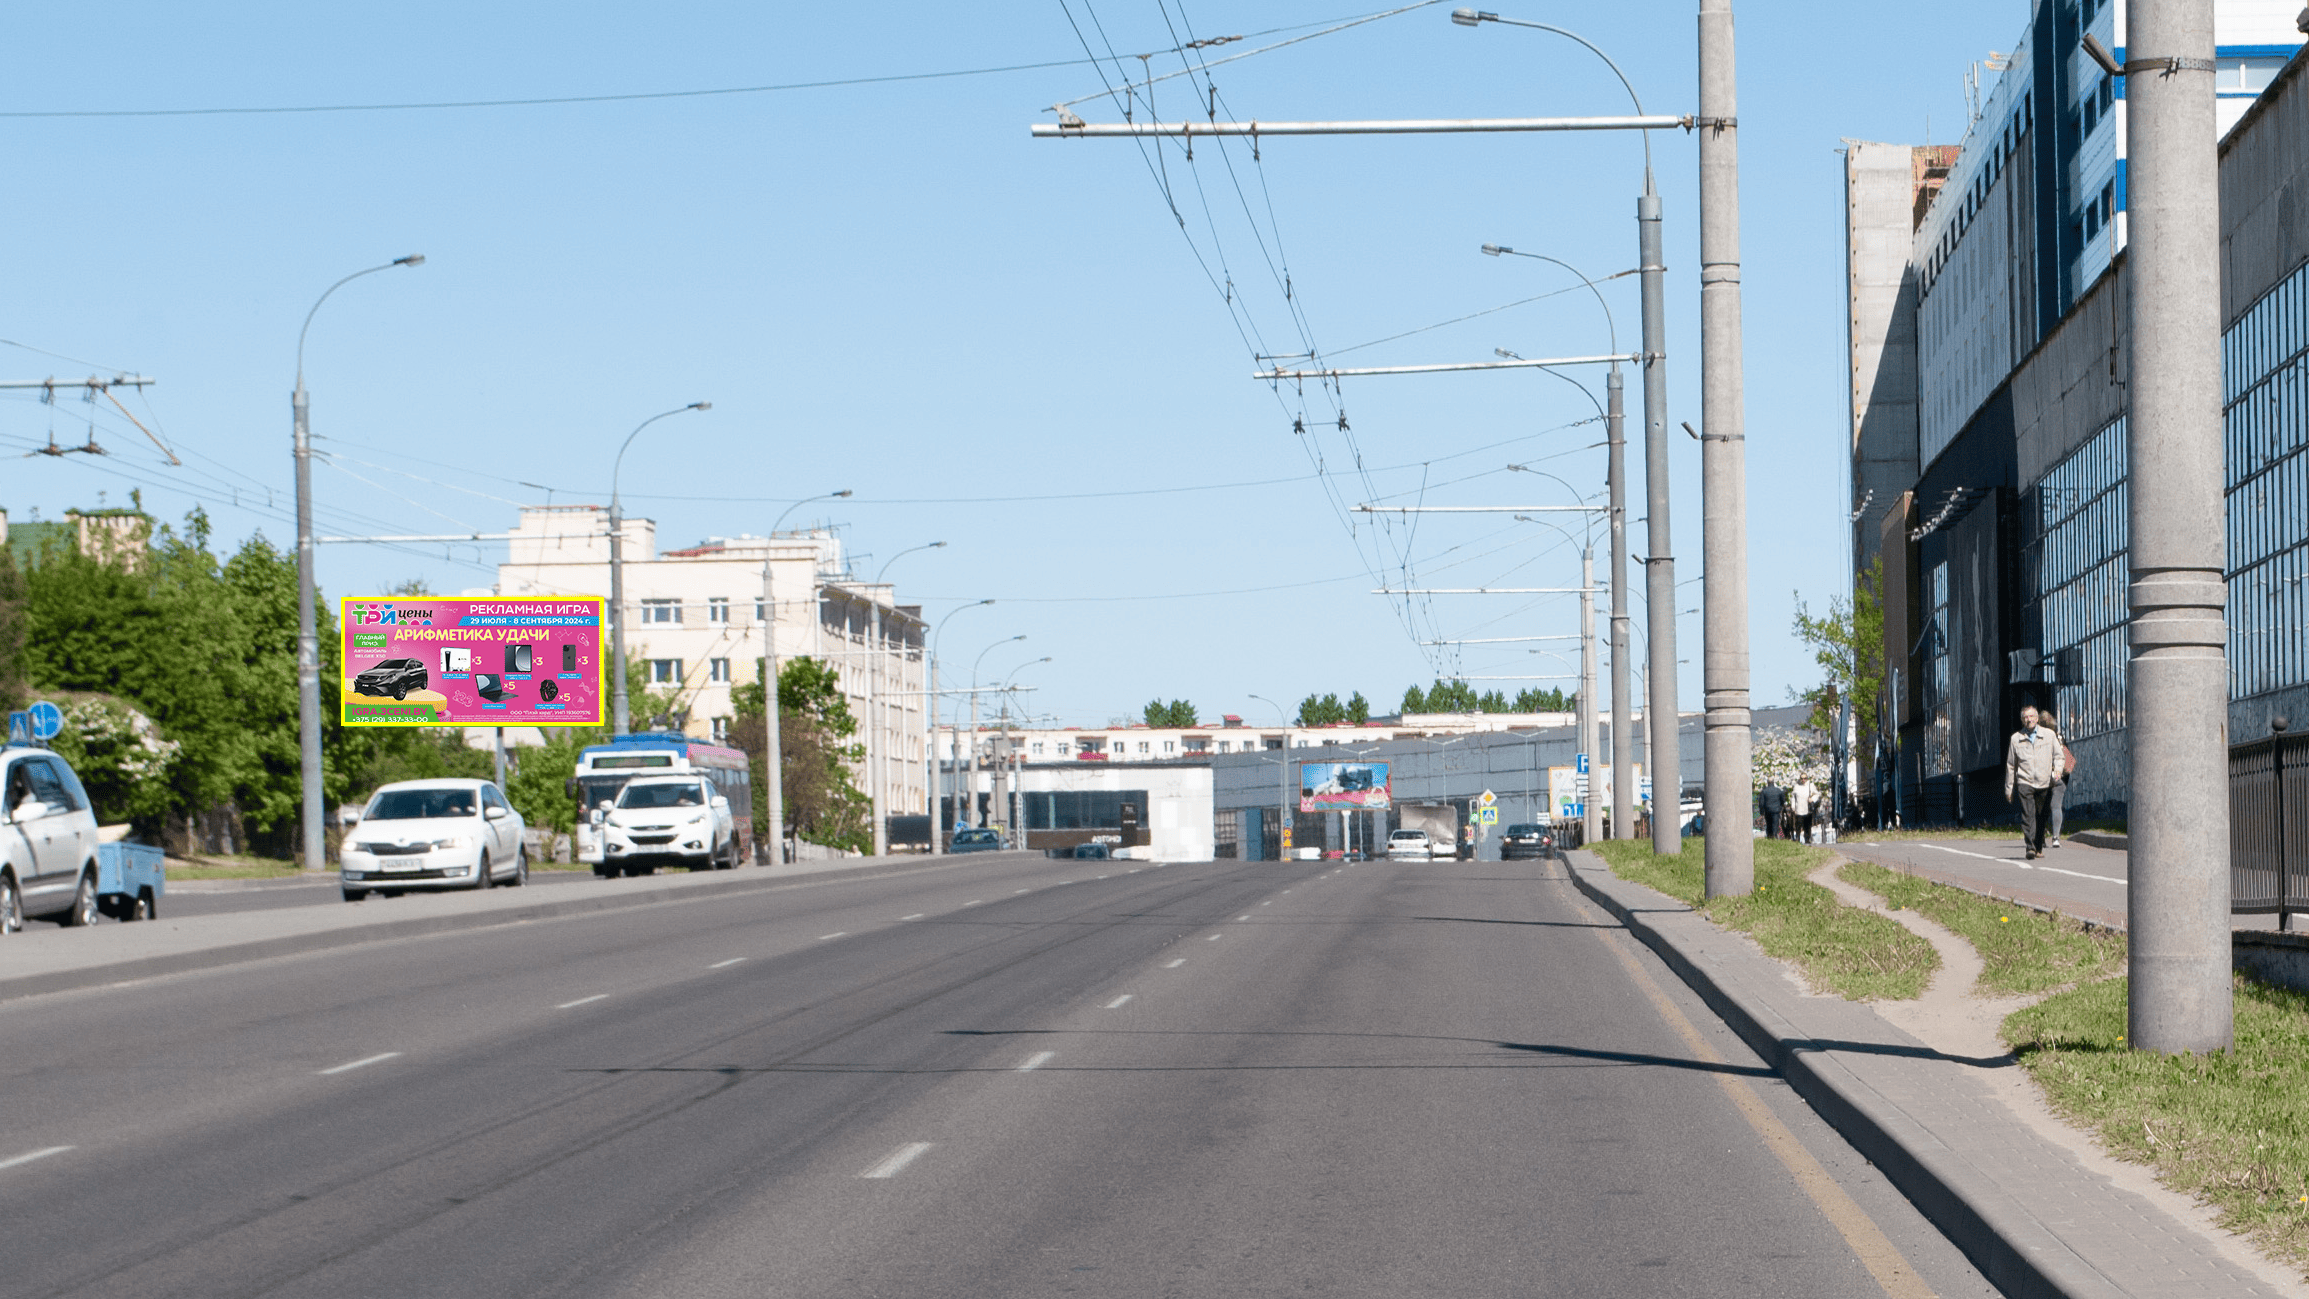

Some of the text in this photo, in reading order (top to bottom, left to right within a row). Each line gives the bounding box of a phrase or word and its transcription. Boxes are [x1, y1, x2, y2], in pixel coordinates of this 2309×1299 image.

[398, 609, 433, 619] цены
[469, 605, 591, 614] РЕКЛАМНАЯ ИГРА
[394, 629, 550, 643] АРИФМЕТИКА УДАЧИ
[352, 707, 428, 715] IGRA.3CENI.BY
